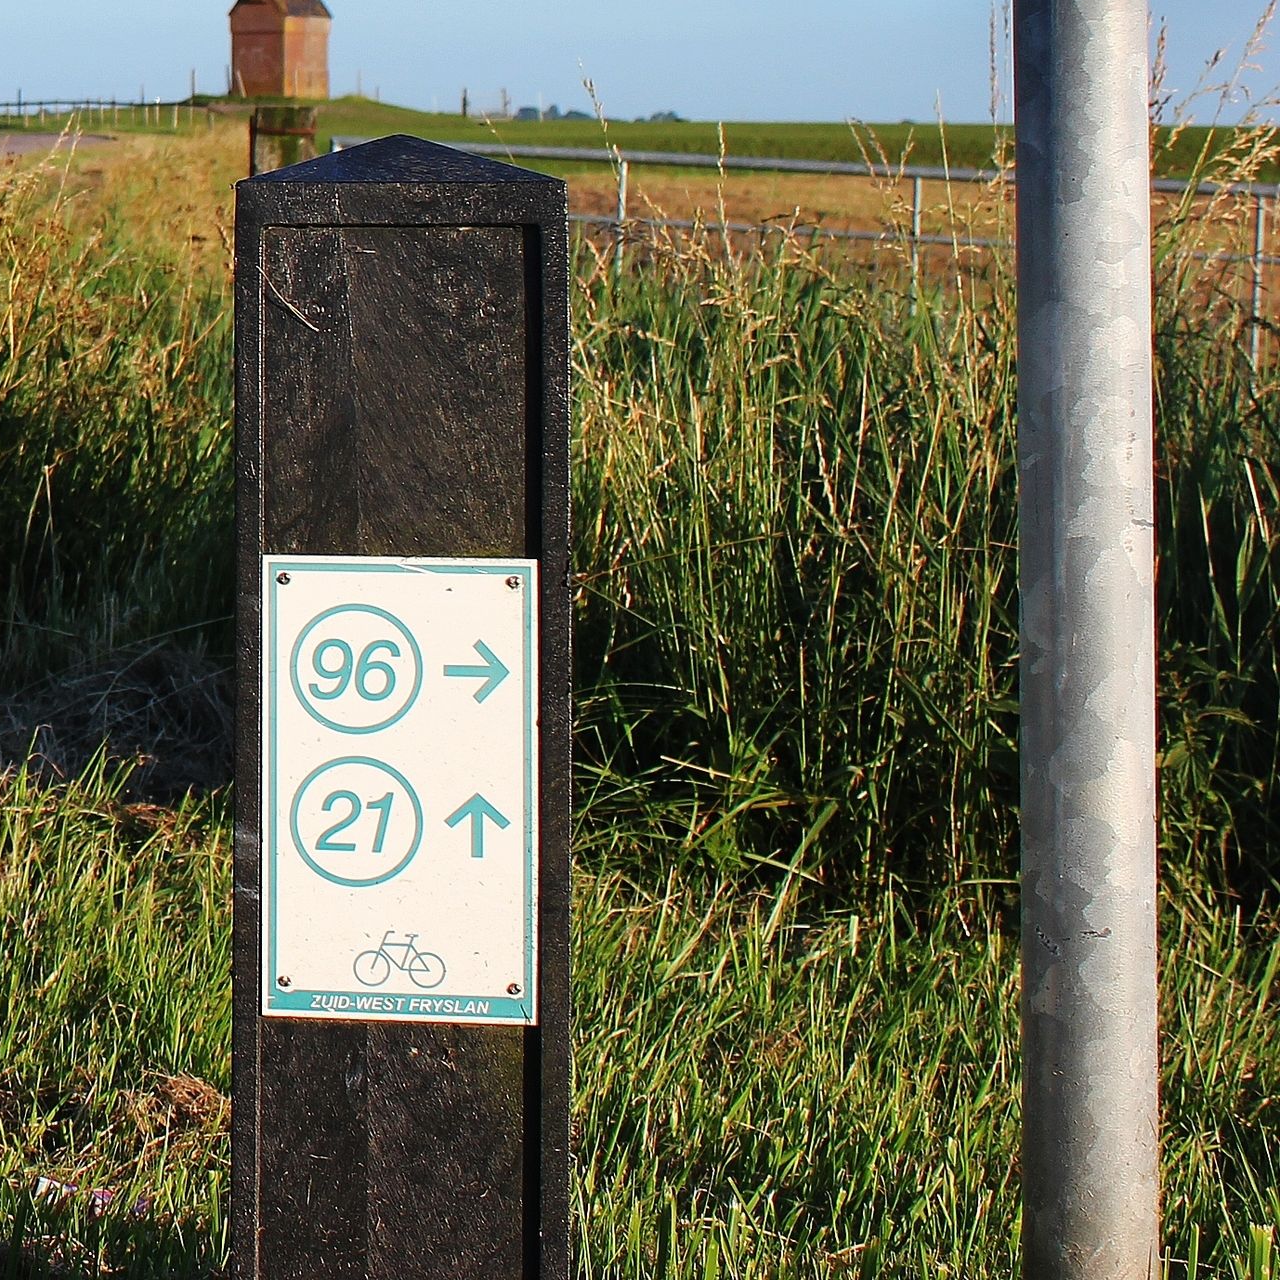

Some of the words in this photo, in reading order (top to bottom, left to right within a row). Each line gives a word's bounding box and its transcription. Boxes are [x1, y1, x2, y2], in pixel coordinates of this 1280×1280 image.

[308, 639, 401, 702] 96
[315, 789, 394, 854] 21
[310, 994, 405, 1013] ZUID-WEST
[408, 998, 489, 1015] FRYSLAN
